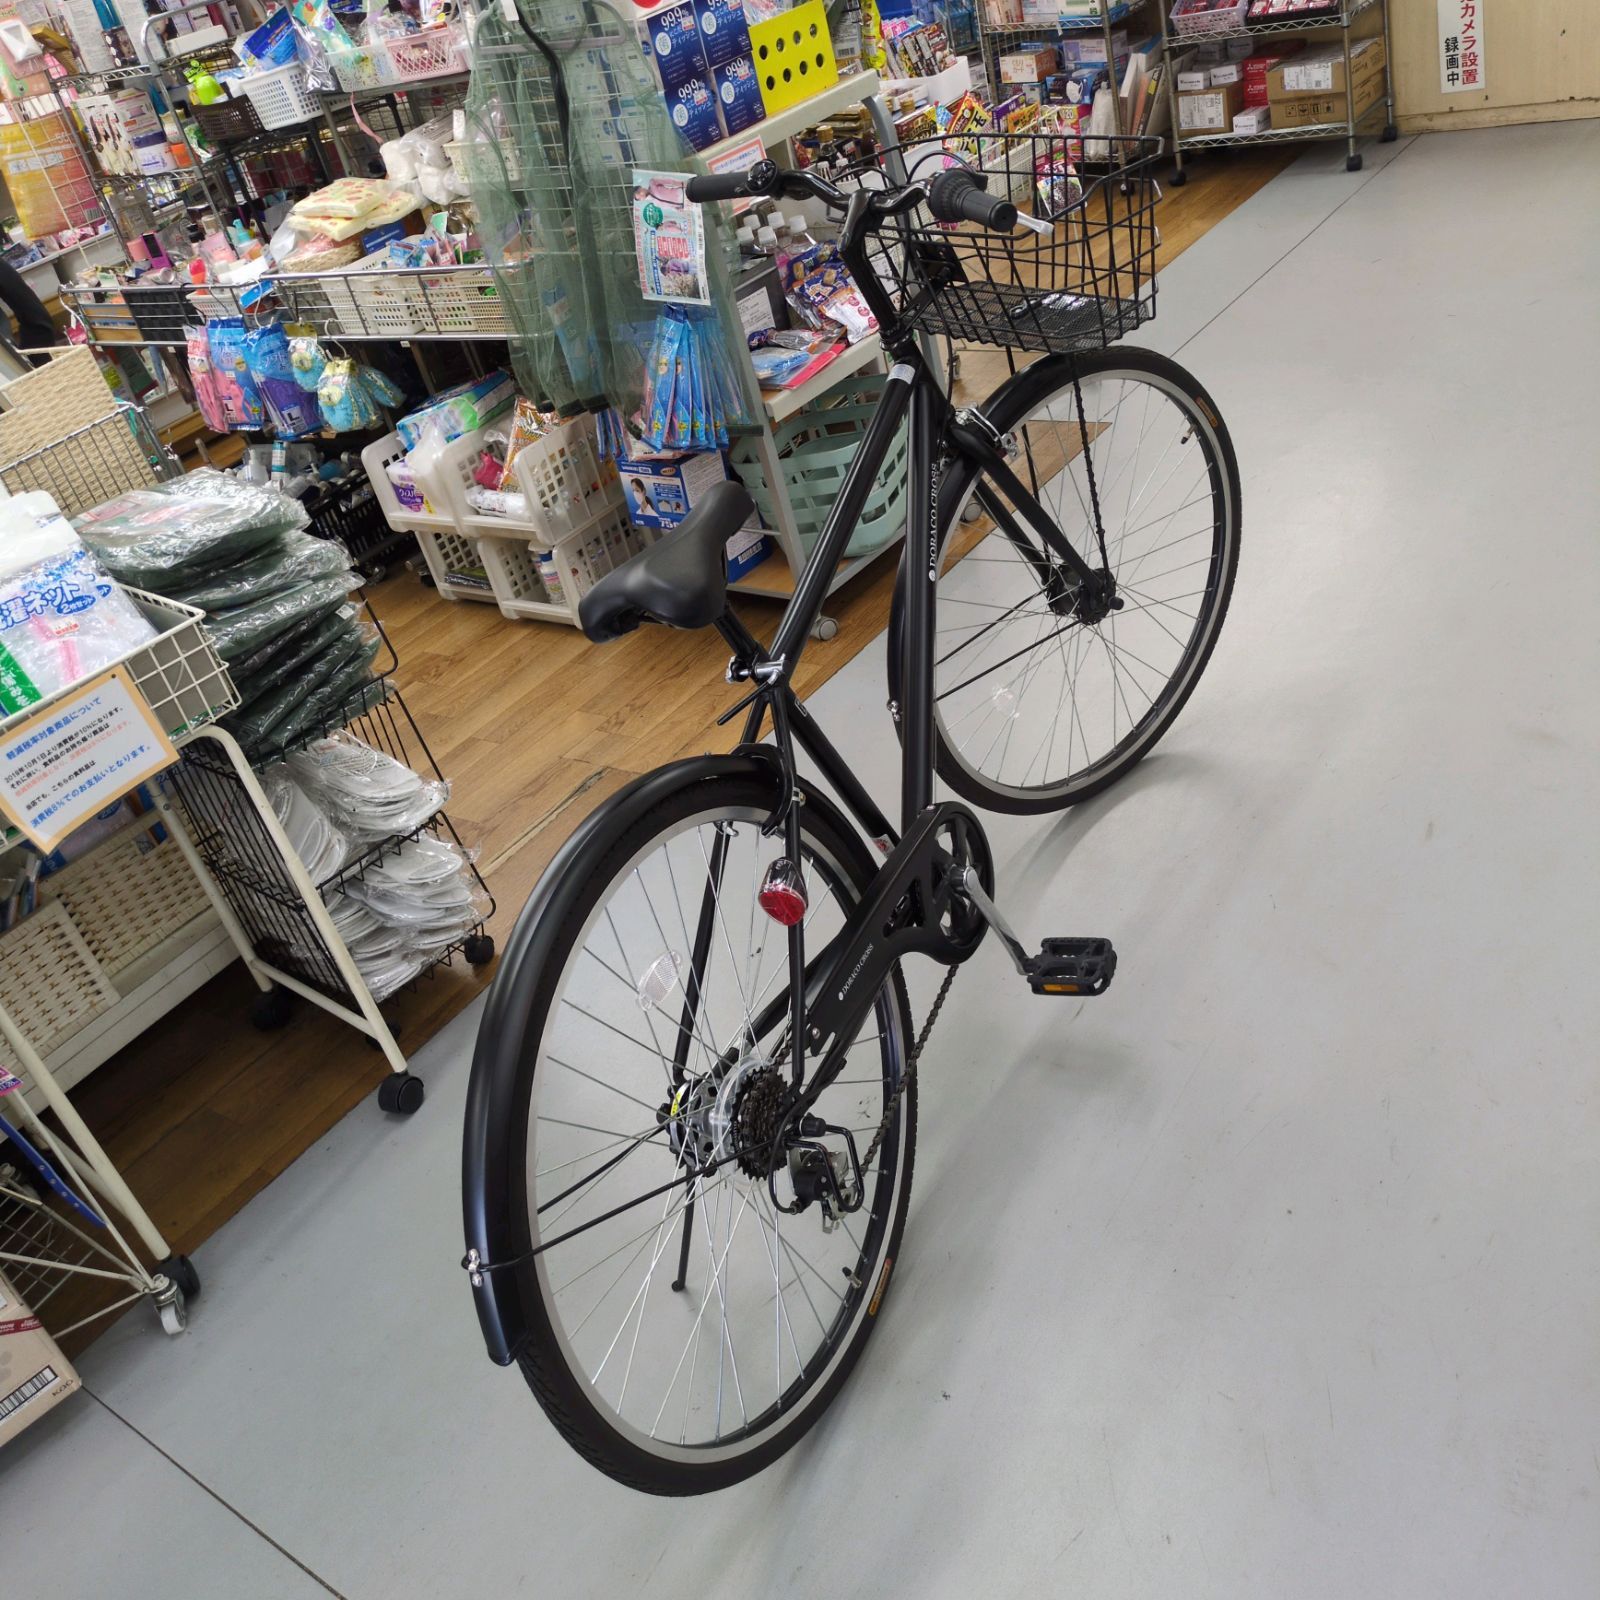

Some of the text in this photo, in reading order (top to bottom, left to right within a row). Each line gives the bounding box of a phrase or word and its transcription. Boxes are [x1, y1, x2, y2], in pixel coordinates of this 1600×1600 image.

[1444, 36, 1459, 86] 録画中
[1460, 0, 1479, 85] カメラ設置
[225, 403, 234, 412] L
[287, 412, 300, 422] L
[6, 696, 102, 760] 軽減税率対象商品について
[31, 745, 151, 828] 消費税8%でのお支払いとなります。
